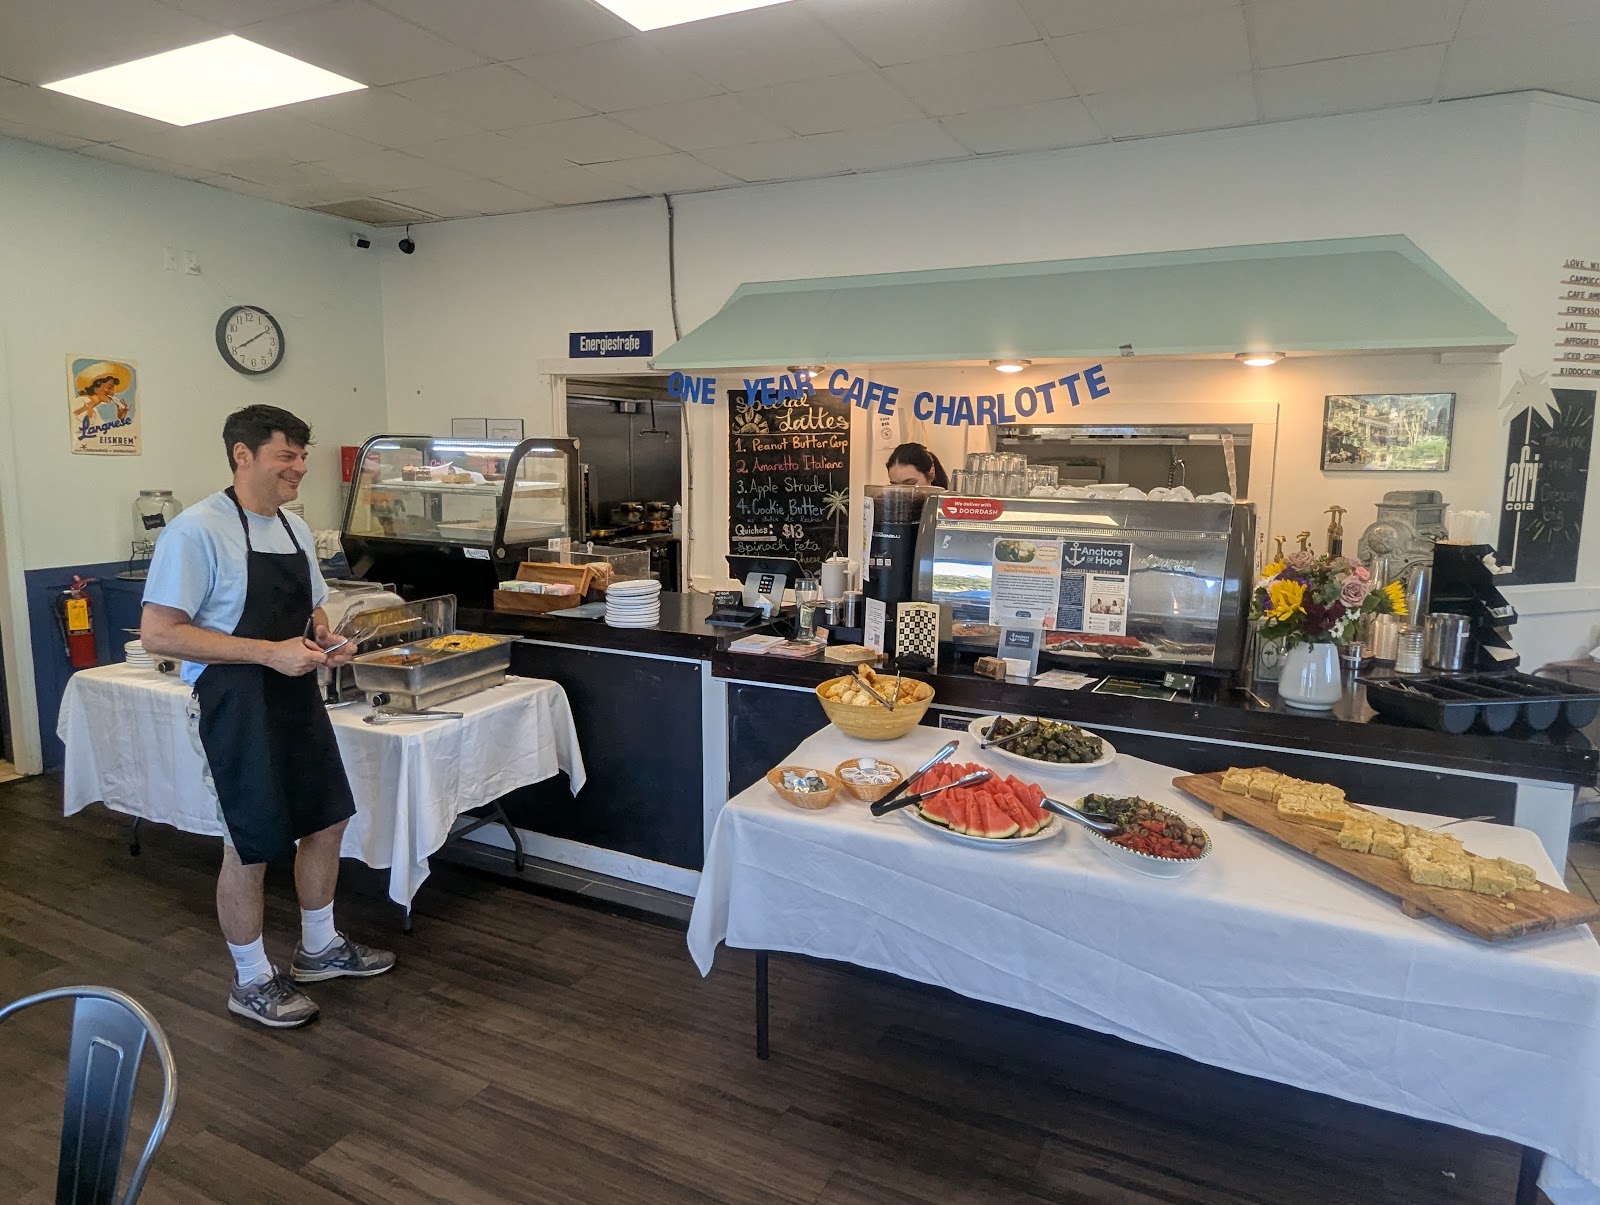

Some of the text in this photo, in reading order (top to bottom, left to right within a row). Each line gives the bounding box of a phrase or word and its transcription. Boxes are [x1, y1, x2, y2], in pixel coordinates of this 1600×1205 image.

[1565, 259, 1585, 269] LOVE
[1567, 289, 1586, 299] CAFE
[1566, 305, 1600, 316] ESPRESSO
[236, 315, 243, 325] 11
[244, 312, 254, 322] 12
[230, 323, 238, 333] 10
[1565, 321, 1588, 331] LATTE
[226, 334, 233, 343] 9
[270, 336, 276, 347] 3
[1564, 337, 1599, 347] AFFOGATO
[579, 334, 640, 355] Energiestraße
[231, 346, 238, 356] 8
[267, 347, 273, 357] 4
[1564, 351, 1581, 361] ICED
[239, 354, 246, 364] 7
[250, 358, 257, 368] 6
[261, 355, 267, 366] 5
[667, 364, 1111, 426] ONE YEAR CAFE CHARLOTTE
[776, 407, 851, 432] Lattes
[78, 414, 132, 441] Langnese
[735, 434, 849, 455] 1. Peanut Butter Cup
[735, 454, 844, 474] 2. Amaretto Italiano
[1506, 444, 1540, 502] afri
[736, 472, 833, 500] 3. Apple Strudel
[736, 496, 827, 517] 4. Cookie Butter
[958, 508, 998, 516] DOORDASH
[1504, 502, 1534, 511] cola
[734, 523, 805, 539] Quiches: $13
[734, 538, 821, 554] Spinach Feta
[1081, 546, 1123, 557] Anchors
[1095, 556, 1123, 567] Hope
